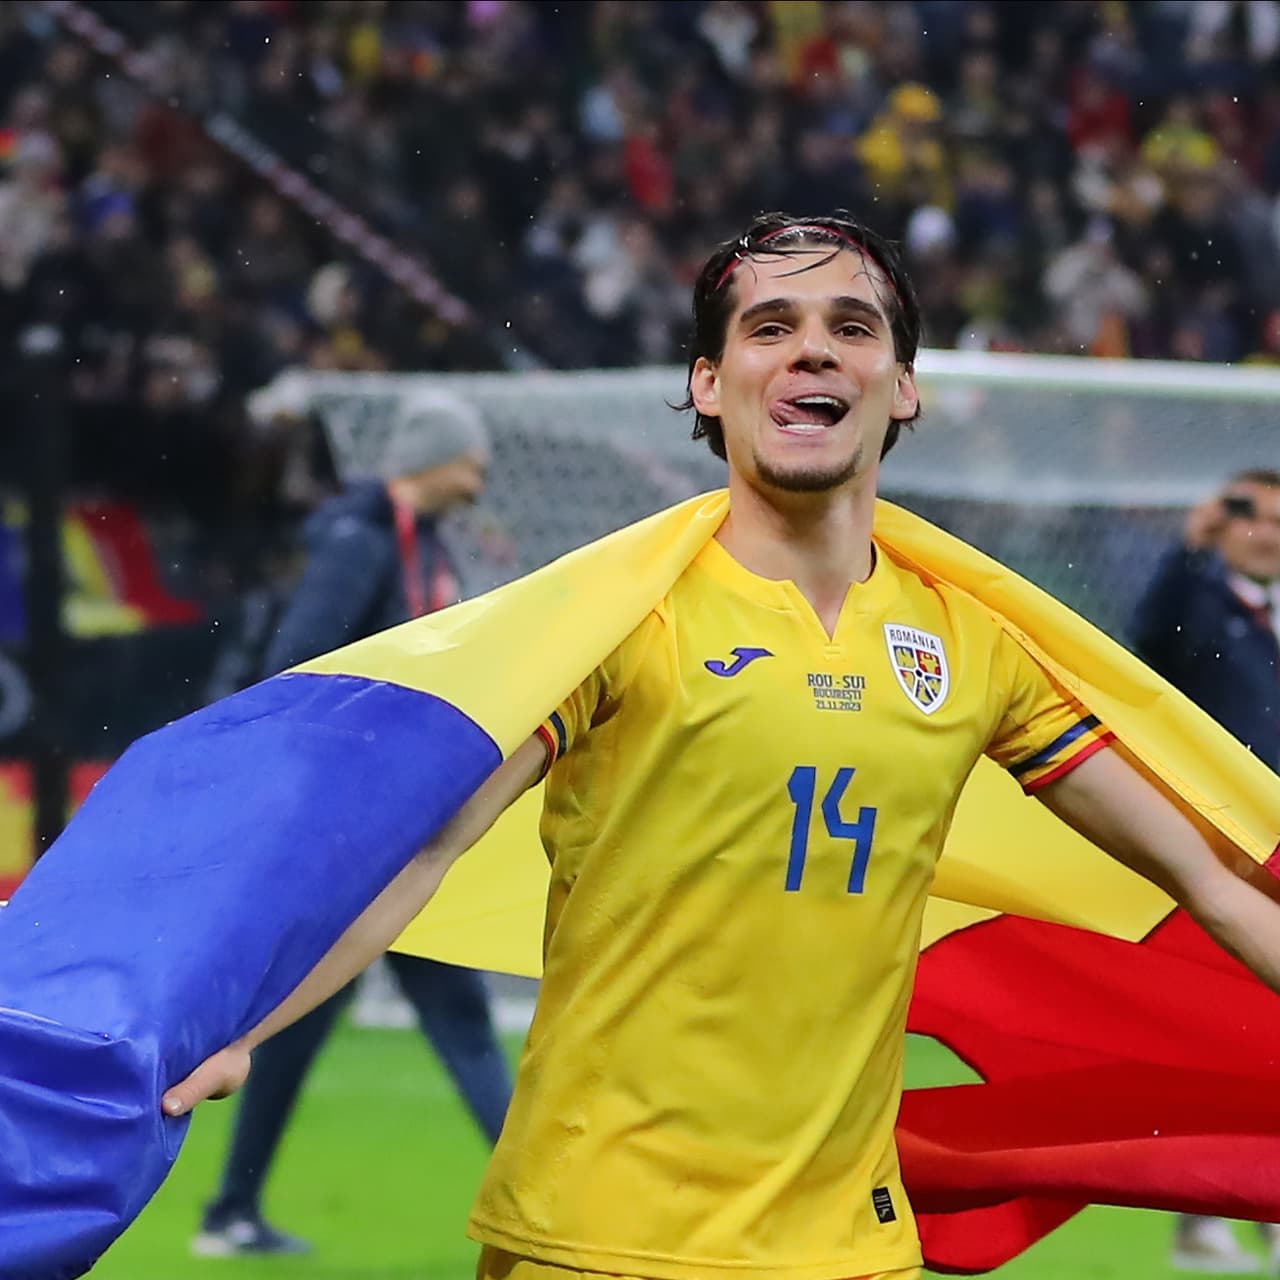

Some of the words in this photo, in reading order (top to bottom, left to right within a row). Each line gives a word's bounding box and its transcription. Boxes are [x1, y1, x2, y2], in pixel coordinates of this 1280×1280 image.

[889, 629, 938, 650] ROMÂNIA
[807, 673, 832, 687] ROU
[843, 675, 866, 689] SUI
[785, 766, 877, 893] 14
